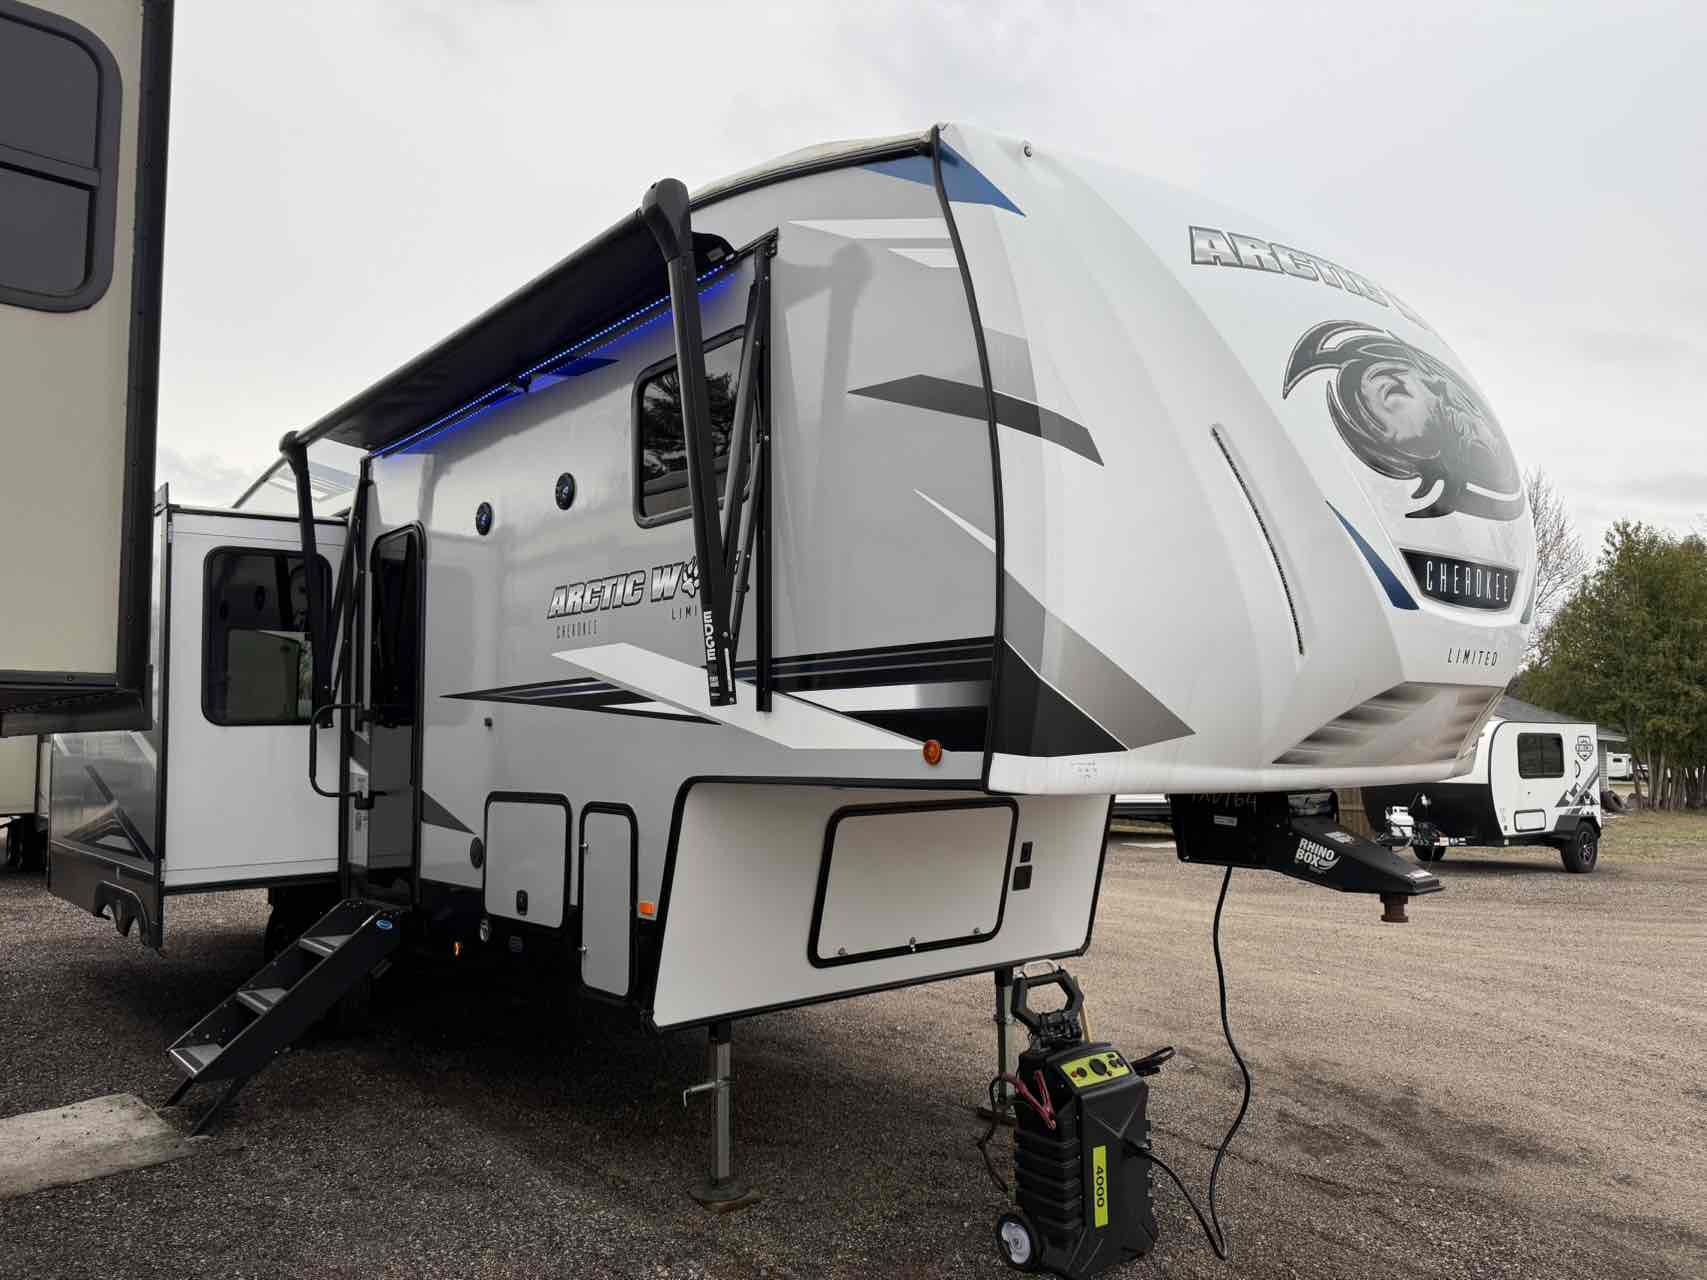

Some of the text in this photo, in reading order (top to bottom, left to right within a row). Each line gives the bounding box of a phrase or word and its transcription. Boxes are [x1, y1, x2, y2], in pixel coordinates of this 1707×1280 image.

[1188, 225, 1389, 307] ARCTIC
[547, 570, 647, 619] ARCTIC
[1425, 559, 1510, 603] CHEROKEE
[671, 603, 698, 621] LIMI
[1447, 647, 1498, 666] LIMITED
[1295, 847, 1321, 868] BOX
[1299, 837, 1335, 861] RHINO
[1096, 1165, 1104, 1207] 4000
